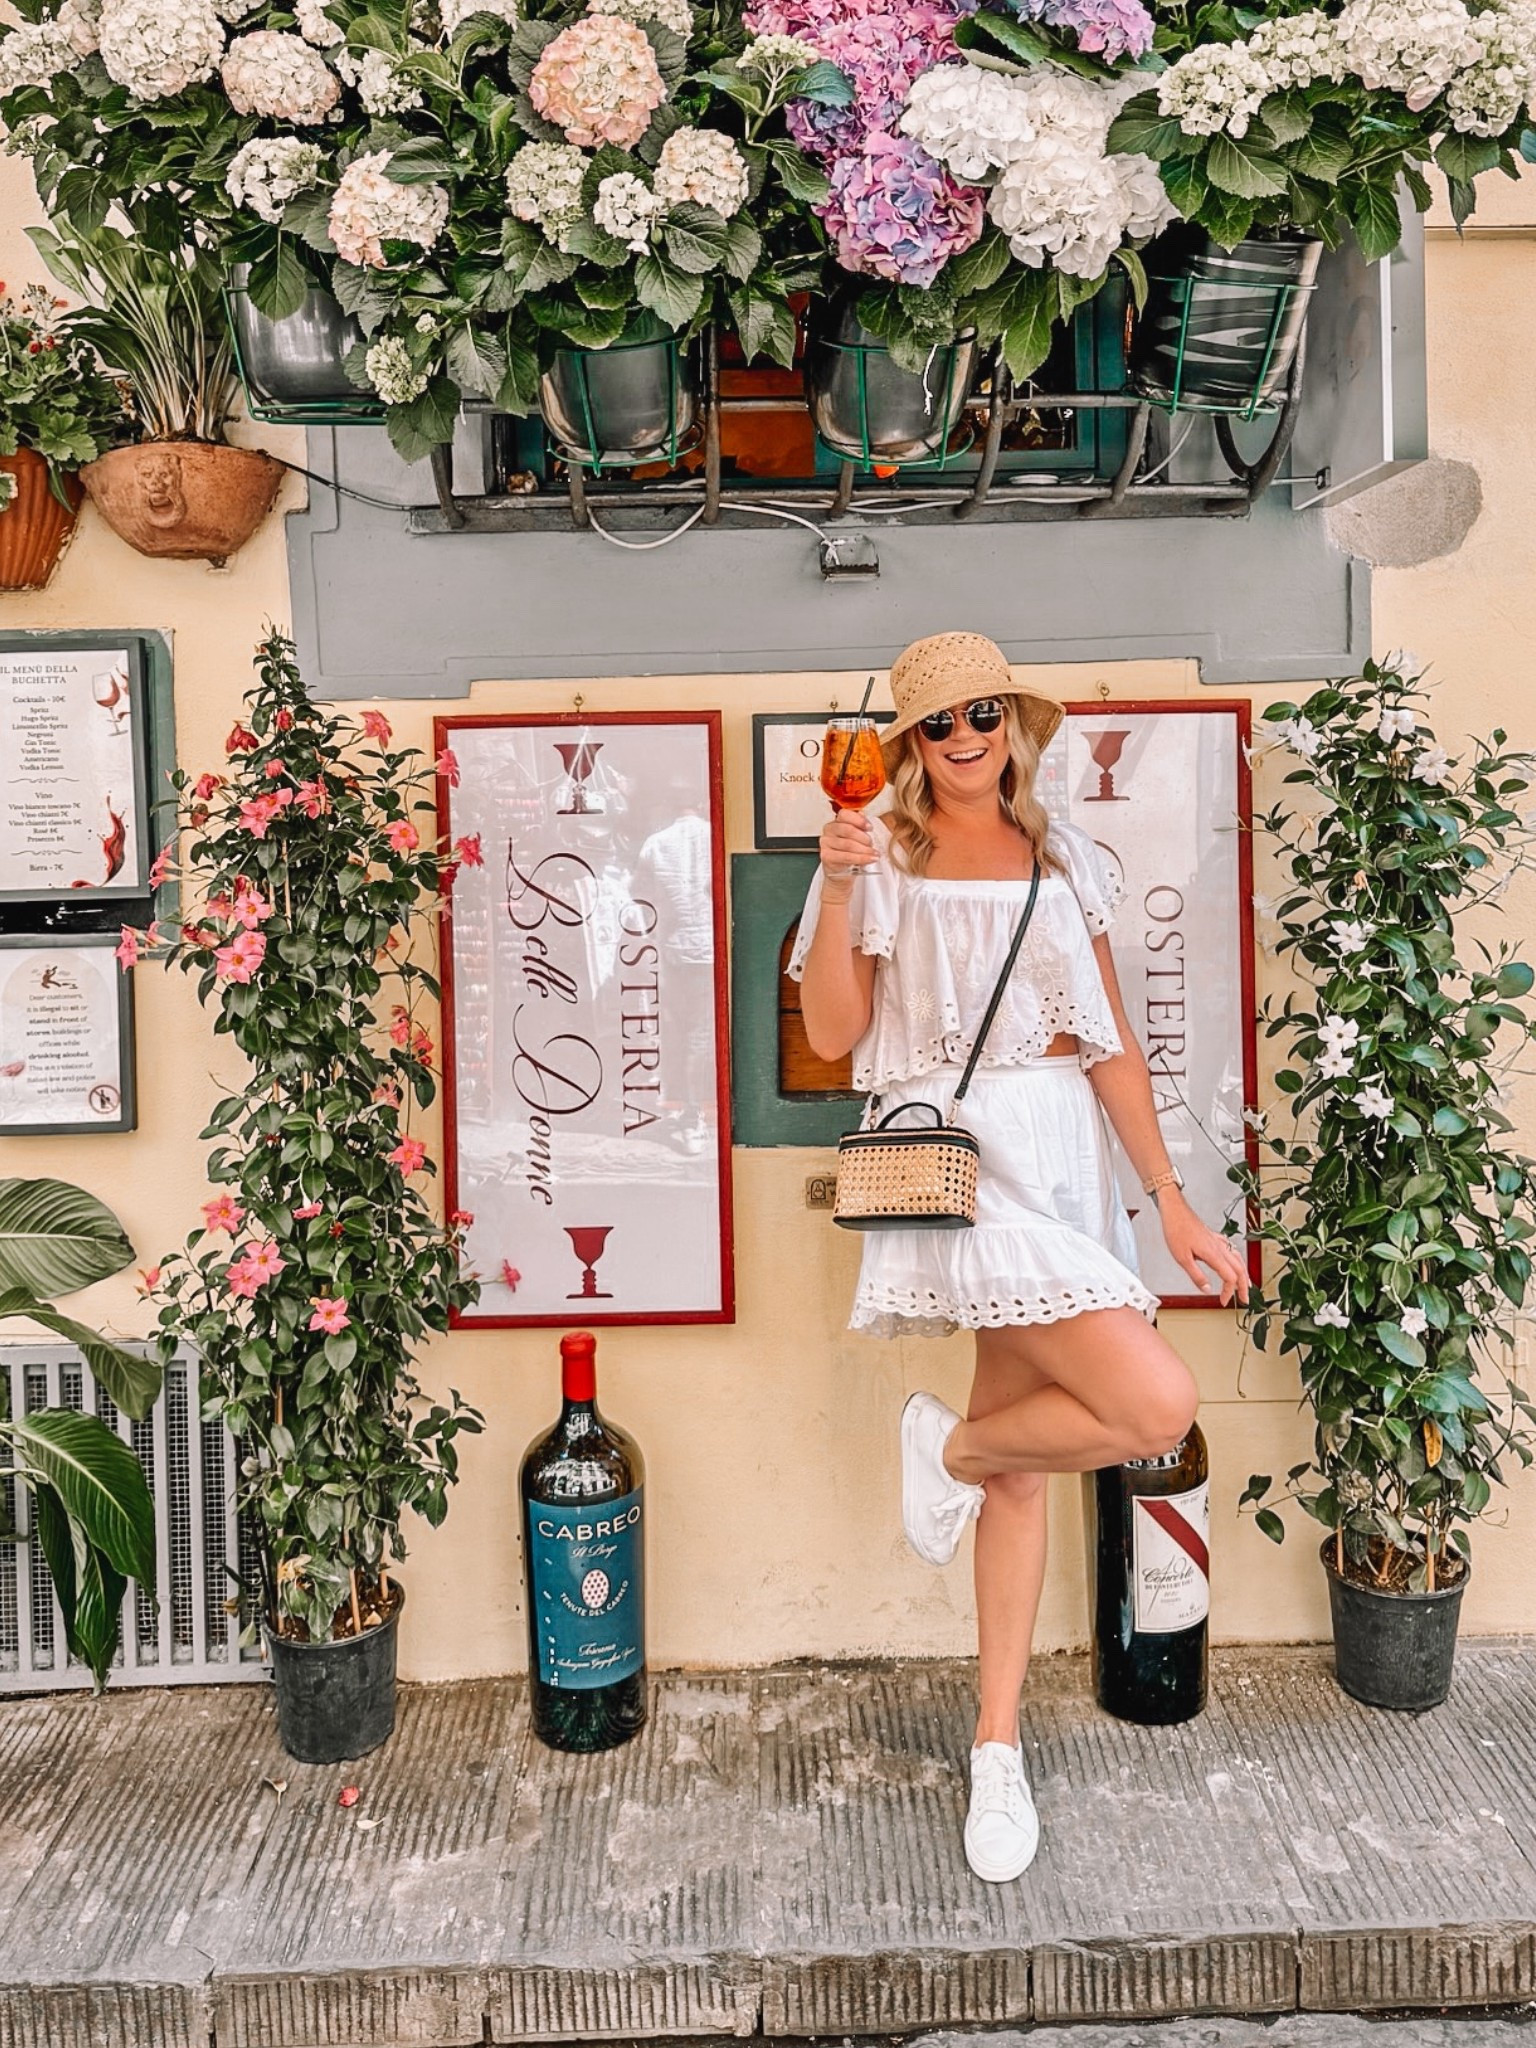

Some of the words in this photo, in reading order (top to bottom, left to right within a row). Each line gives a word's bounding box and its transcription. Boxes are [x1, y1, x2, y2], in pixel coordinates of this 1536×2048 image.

[0, 666, 10, 674] IL
[45, 665, 78, 673] DELLA
[12, 676, 67, 684] BUCHETTA
[780, 772, 815, 783] Knock
[29, 864, 48, 872] Birra
[506, 837, 600, 1004] Belle
[618, 898, 662, 1137] OSTERIA
[1143, 885, 1187, 1115] OSTERIA
[512, 1004, 603, 1206] Donne
[538, 1505, 641, 1541] CABREO
[560, 1592, 588, 1617] TENUTE
[588, 1609, 606, 1617] DEL
[606, 1580, 629, 1611] CABREO
